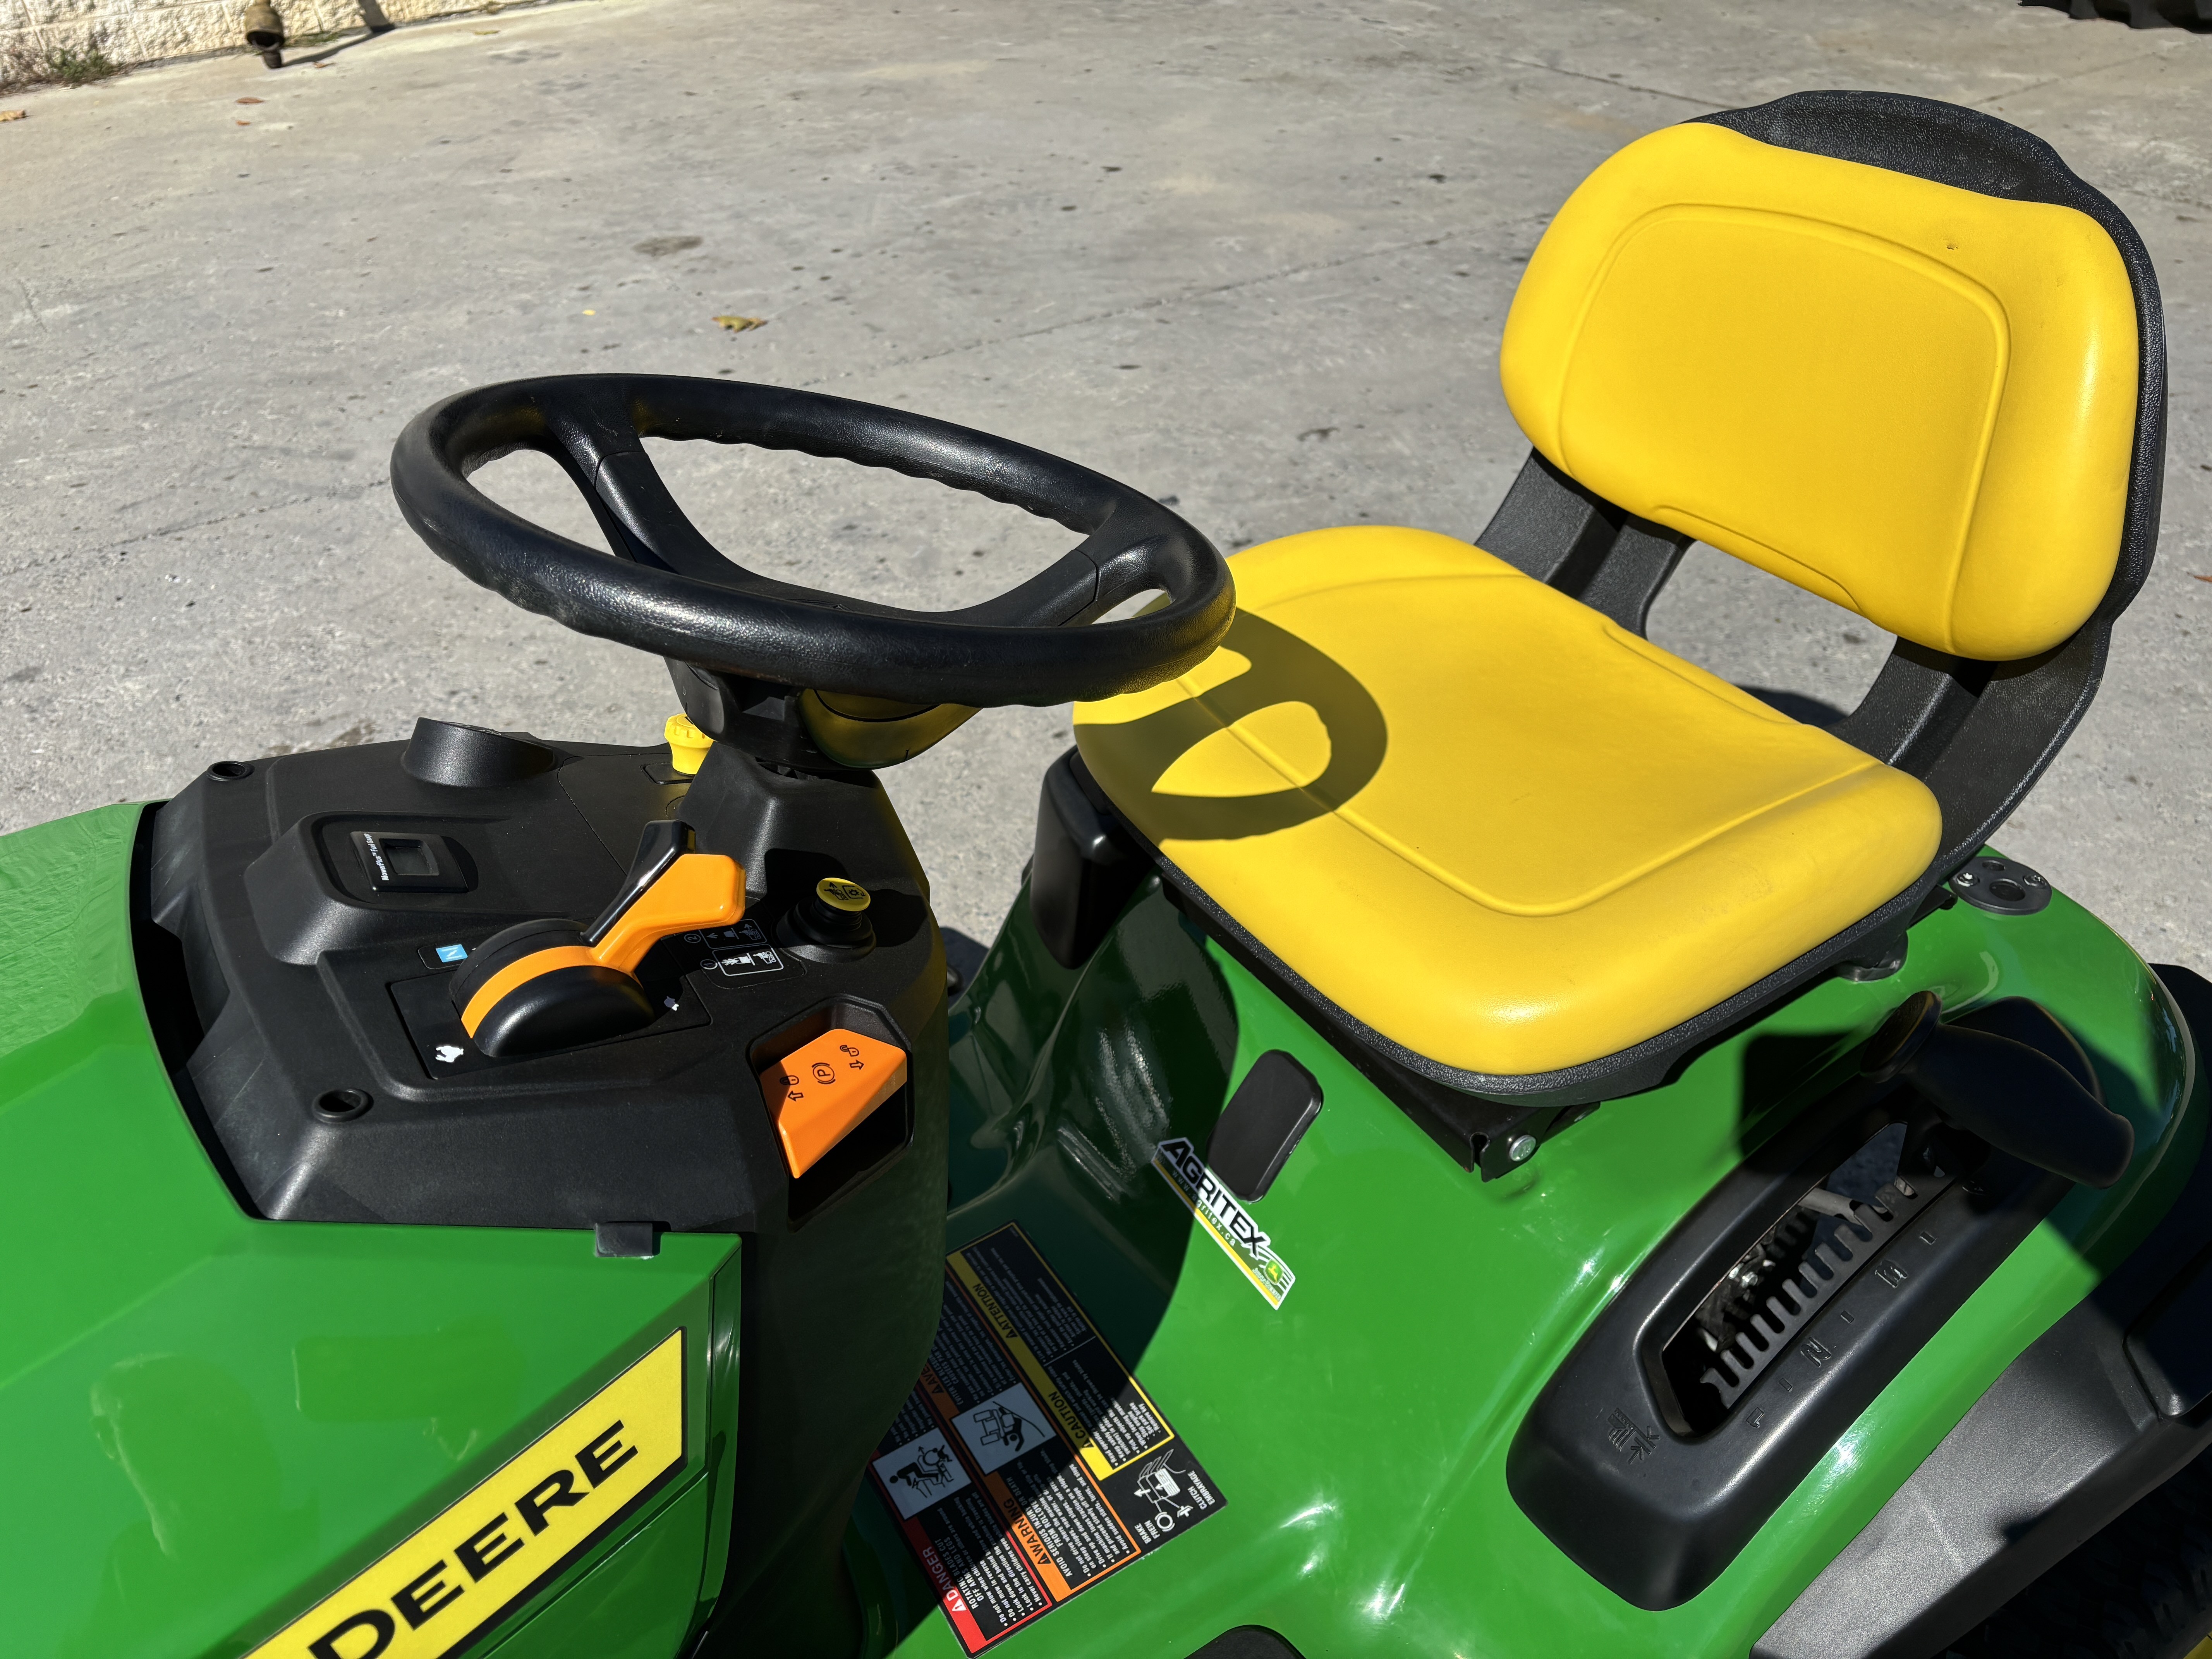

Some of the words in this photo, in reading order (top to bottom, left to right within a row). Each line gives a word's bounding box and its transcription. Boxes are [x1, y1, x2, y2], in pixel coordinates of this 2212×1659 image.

[1161, 1141, 1267, 1257] AGRITEX
[1173, 1170, 1236, 1246] www.agritex.ca
[972, 1283, 1012, 1329] ATTENTION
[1801, 1337, 1831, 1367] 2
[1048, 1391, 1085, 1438] CAUTION
[1069, 1464, 1080, 1477] stops
[1006, 1477, 1021, 1496] DEATH
[1046, 1477, 1058, 1492] across
[1056, 1473, 1068, 1489] slope,
[1077, 1477, 1086, 1486] and
[1187, 1470, 1215, 1505] EMBRAYAGE
[1018, 1496, 1027, 1505] OR
[1055, 1491, 1064, 1501] not
[1073, 1487, 1084, 1501] slope
[1085, 1486, 1096, 1501] turns,
[1187, 1486, 1207, 1510] CLUTCH
[1028, 1496, 1051, 1528] ROLLOVER
[1039, 1497, 1055, 1518] machine
[1051, 1500, 1062, 1516] water,
[1063, 1500, 1076, 1518] slopes,
[1072, 1499, 1087, 1519] traction
[1095, 1501, 1107, 1517] starts,
[1025, 1506, 1042, 1529] INJURY
[1052, 1517, 1060, 1527] the
[1060, 1516, 1070, 1528] near
[1087, 1508, 1100, 1524] slowly
[1003, 1498, 1042, 1556] WARNING
[1073, 1518, 1084, 1532] down
[1085, 1518, 1096, 1532] loses
[1104, 1516, 1118, 1535] sudden
[1144, 1520, 1160, 1539] FREIN
[308, 1419, 638, 1659] DEERE
[1048, 1528, 1063, 1547] FROM
[1058, 1526, 1070, 1542] where
[1069, 1528, 1082, 1546] slopes,
[1081, 1532, 1091, 1542] and
[1097, 1524, 1114, 1544] proceed
[1134, 1523, 1151, 1544] BRAKE
[935, 1539, 945, 1551] CUT
[944, 1537, 957, 1553] LEGS
[1000, 1538, 1010, 1550] even
[1039, 1528, 1059, 1556] SERIOUS
[1068, 1542, 1079, 1555] drive
[1094, 1532, 1110, 1553] machine
[1110, 1544, 1120, 1554] and
[1115, 1535, 1128, 1549] Avoid
[954, 1554, 965, 1567] AND
[1008, 1550, 1023, 1571] children
[1075, 1555, 1084, 1564] not
[1080, 1547, 1091, 1561] steep
[1093, 1549, 1104, 1564] Drive
[943, 1552, 960, 1576] BLADES
[966, 1555, 980, 1576] children
[980, 1560, 993, 1579] reverse
[987, 1555, 1001, 1573] behind
[999, 1554, 1015, 1577] direction
[1056, 1557, 1072, 1576] AVOID
[1082, 1565, 1089, 1573] Do
[923, 1546, 960, 1601] DANGER
[962, 1568, 976, 1587] ARMS
[998, 1573, 1007, 1583] and
[1020, 1571, 1031, 1585] carry
[977, 1576, 988, 1591] when
[1005, 1583, 1016, 1598] down
[956, 1576, 978, 1609] ROTATING
[972, 1589, 984, 1601] OFF
[986, 1591, 996, 1604] mow
[994, 1586, 1005, 1599] mow
[1021, 1593, 1032, 1607] Look
[1028, 1586, 1041, 1602] Never
[993, 1604, 1001, 1613] not
[1001, 1599, 1010, 1608] not
[1013, 1598, 1024, 1612] Look
[999, 1614, 1006, 1622] Do
[1008, 1609, 1015, 1617] Do
